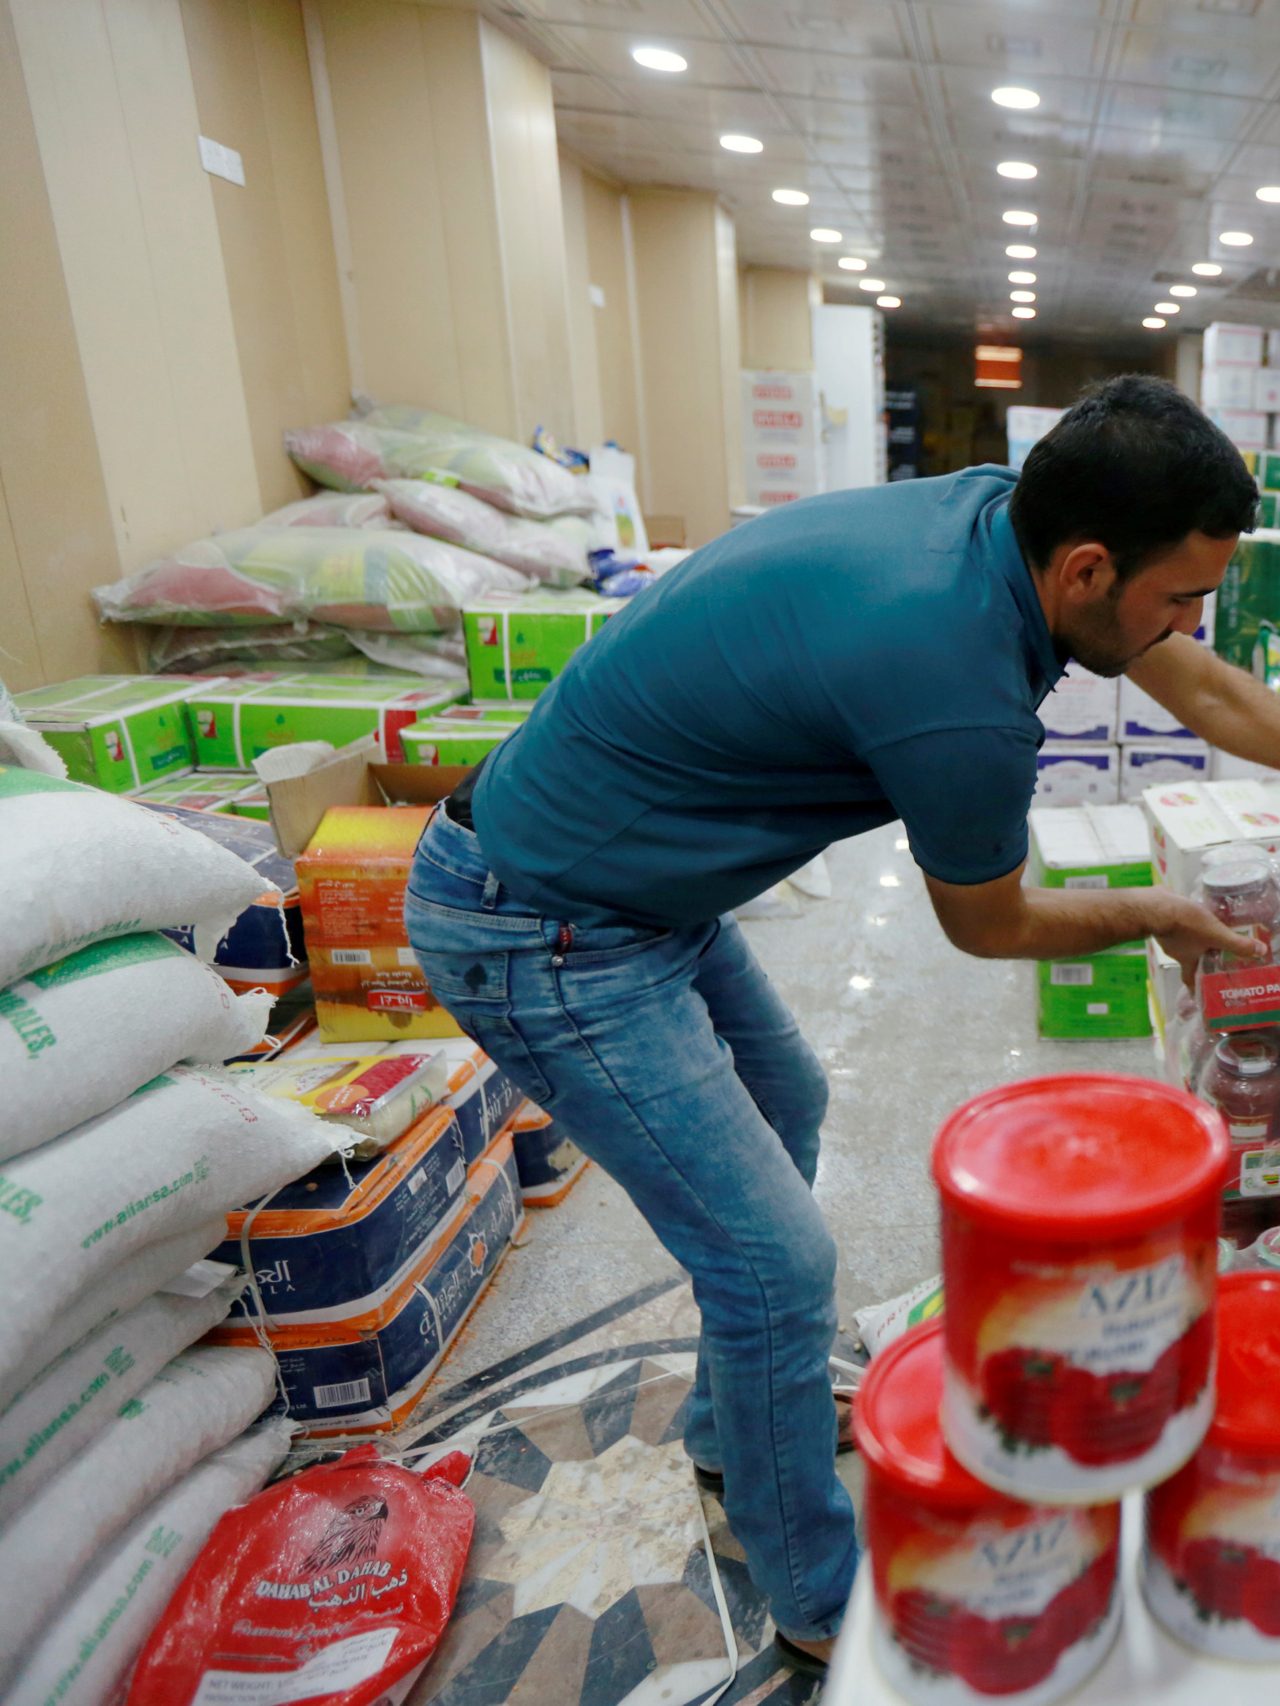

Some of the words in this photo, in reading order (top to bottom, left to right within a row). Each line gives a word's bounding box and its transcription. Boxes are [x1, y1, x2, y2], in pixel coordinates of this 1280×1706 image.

[1218, 985, 1266, 1001] TOMATO
[255, 1579, 311, 1600] DAHAB
[313, 1575, 334, 1594] AL
[336, 1560, 392, 1585] DAHAB
[370, 1568, 409, 1600] ذهب
[308, 1582, 367, 1613] الذهب
